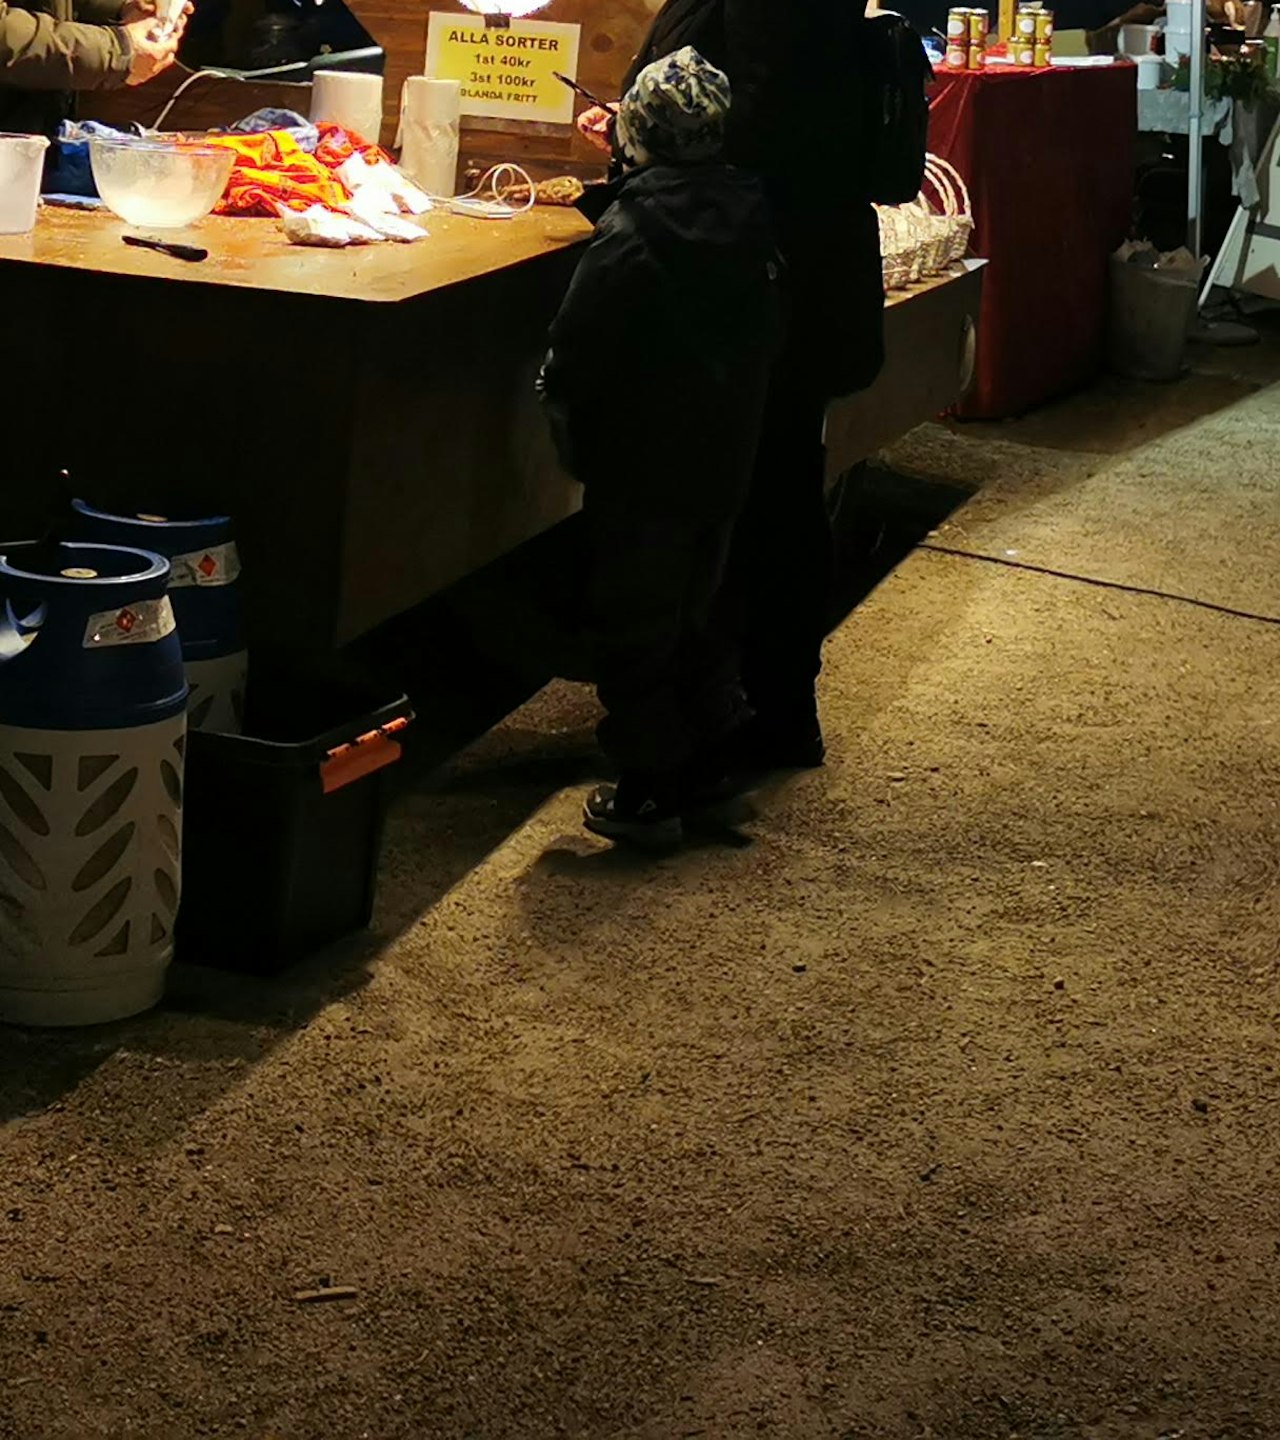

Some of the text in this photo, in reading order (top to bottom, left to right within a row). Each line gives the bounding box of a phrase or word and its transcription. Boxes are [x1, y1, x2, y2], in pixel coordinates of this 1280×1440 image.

[448, 30, 559, 52] ALLA SORTER
[475, 53, 532, 69] 1st 40kr
[470, 71, 537, 88] 3st 100kr
[507, 92, 539, 103] FRITT
